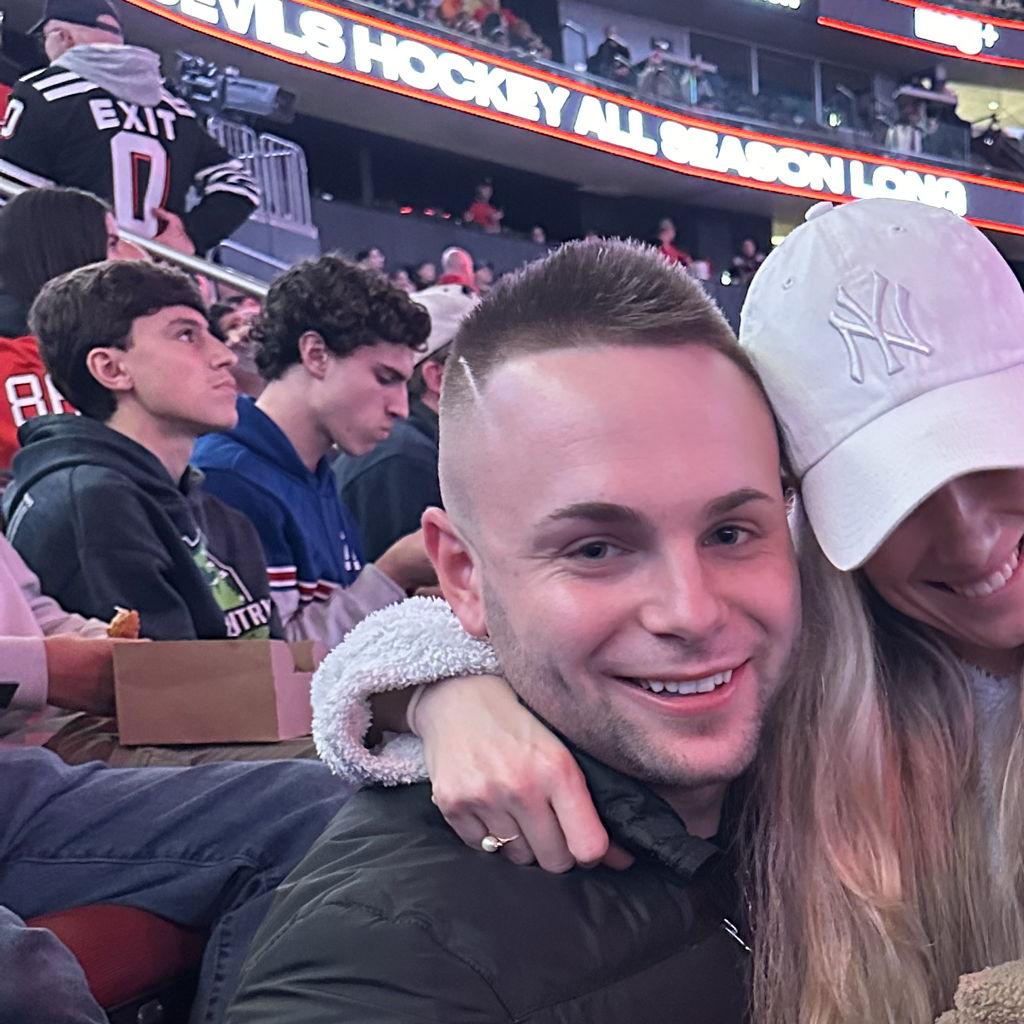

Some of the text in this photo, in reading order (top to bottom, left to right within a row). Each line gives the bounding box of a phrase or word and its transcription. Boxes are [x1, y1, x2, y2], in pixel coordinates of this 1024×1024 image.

[88, 98, 176, 141] EXIT
[154, 0, 968, 217] EVILS HOCKEY ALL SEASON LONG
[829, 270, 933, 384] NY
